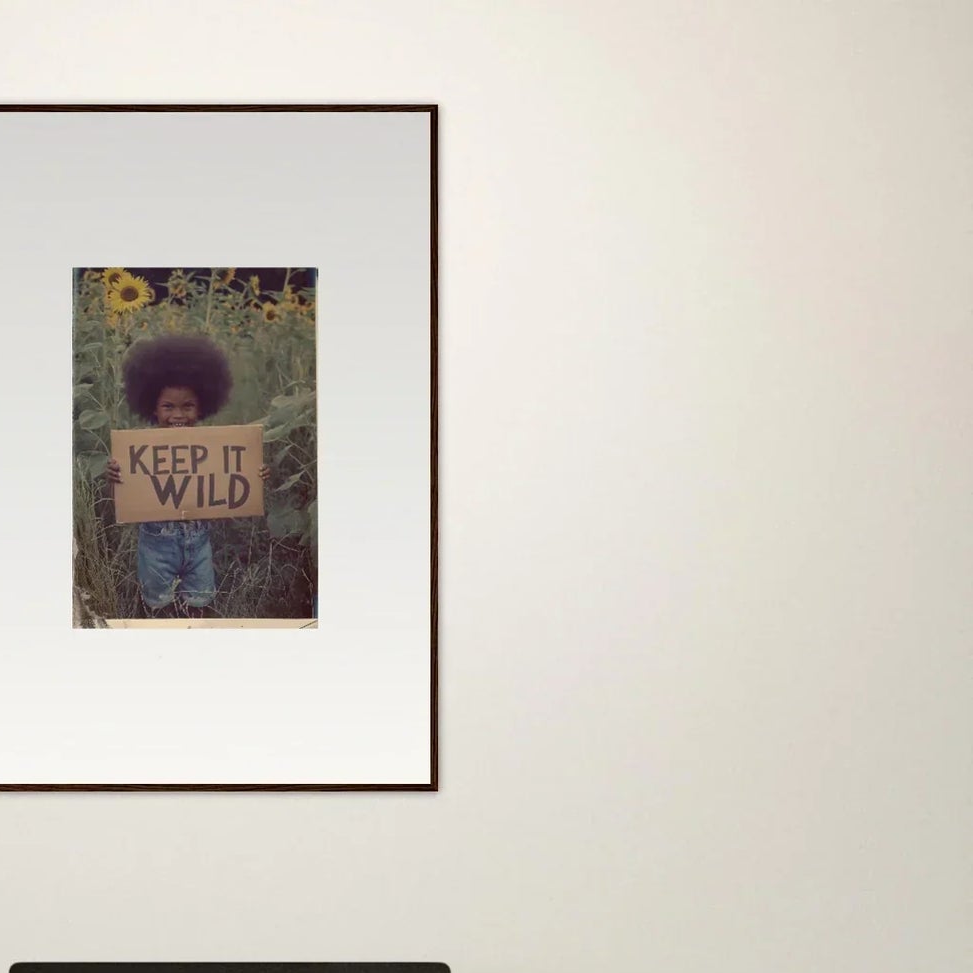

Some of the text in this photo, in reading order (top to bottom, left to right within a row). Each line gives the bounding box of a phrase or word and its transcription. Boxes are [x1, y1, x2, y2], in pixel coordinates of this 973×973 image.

[129, 444, 247, 475] KEEP IT
[150, 473, 251, 509] WILD
